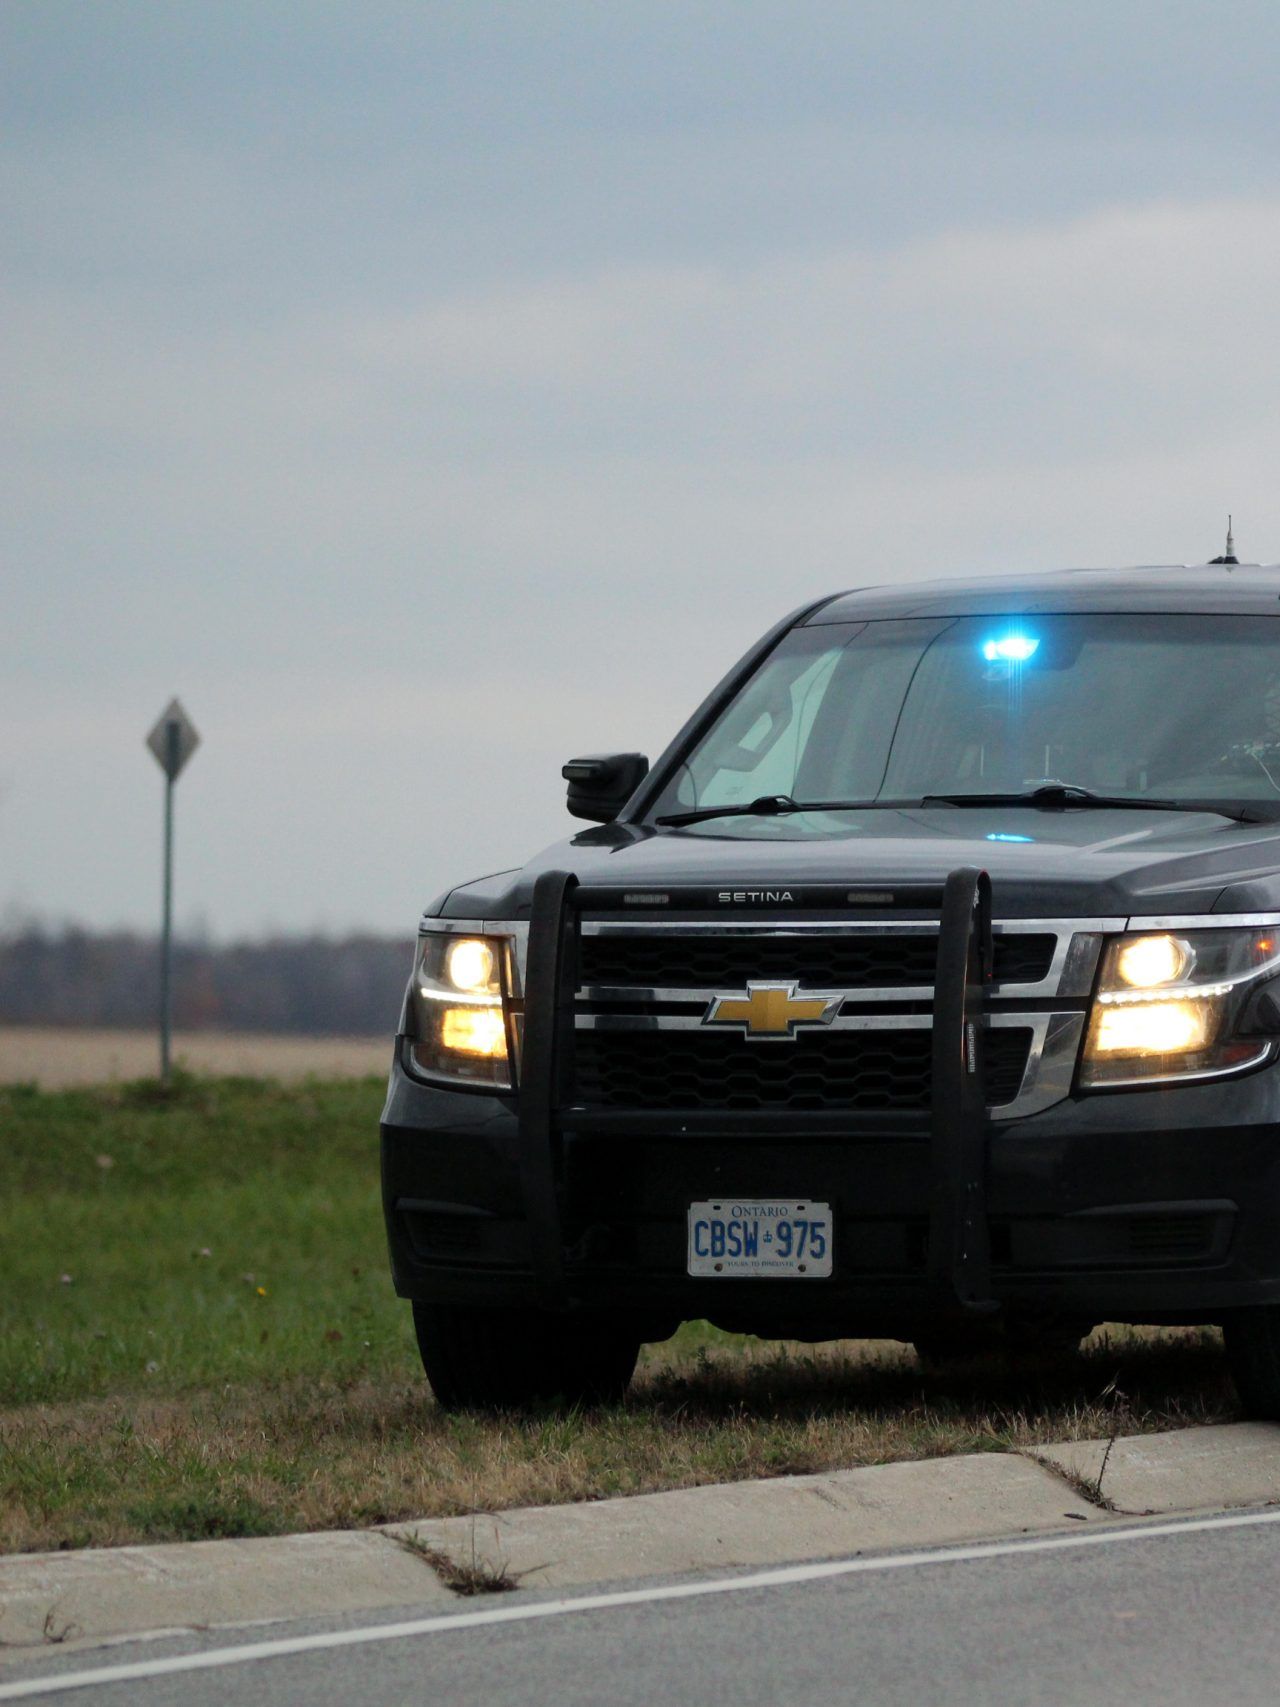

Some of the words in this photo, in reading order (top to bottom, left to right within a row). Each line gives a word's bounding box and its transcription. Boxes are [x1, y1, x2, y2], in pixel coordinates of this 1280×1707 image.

[718, 891, 794, 902] SETINA
[731, 1205, 788, 1218] ONTARIO
[694, 1220, 759, 1258] CBSW
[775, 1220, 826, 1259] 975
